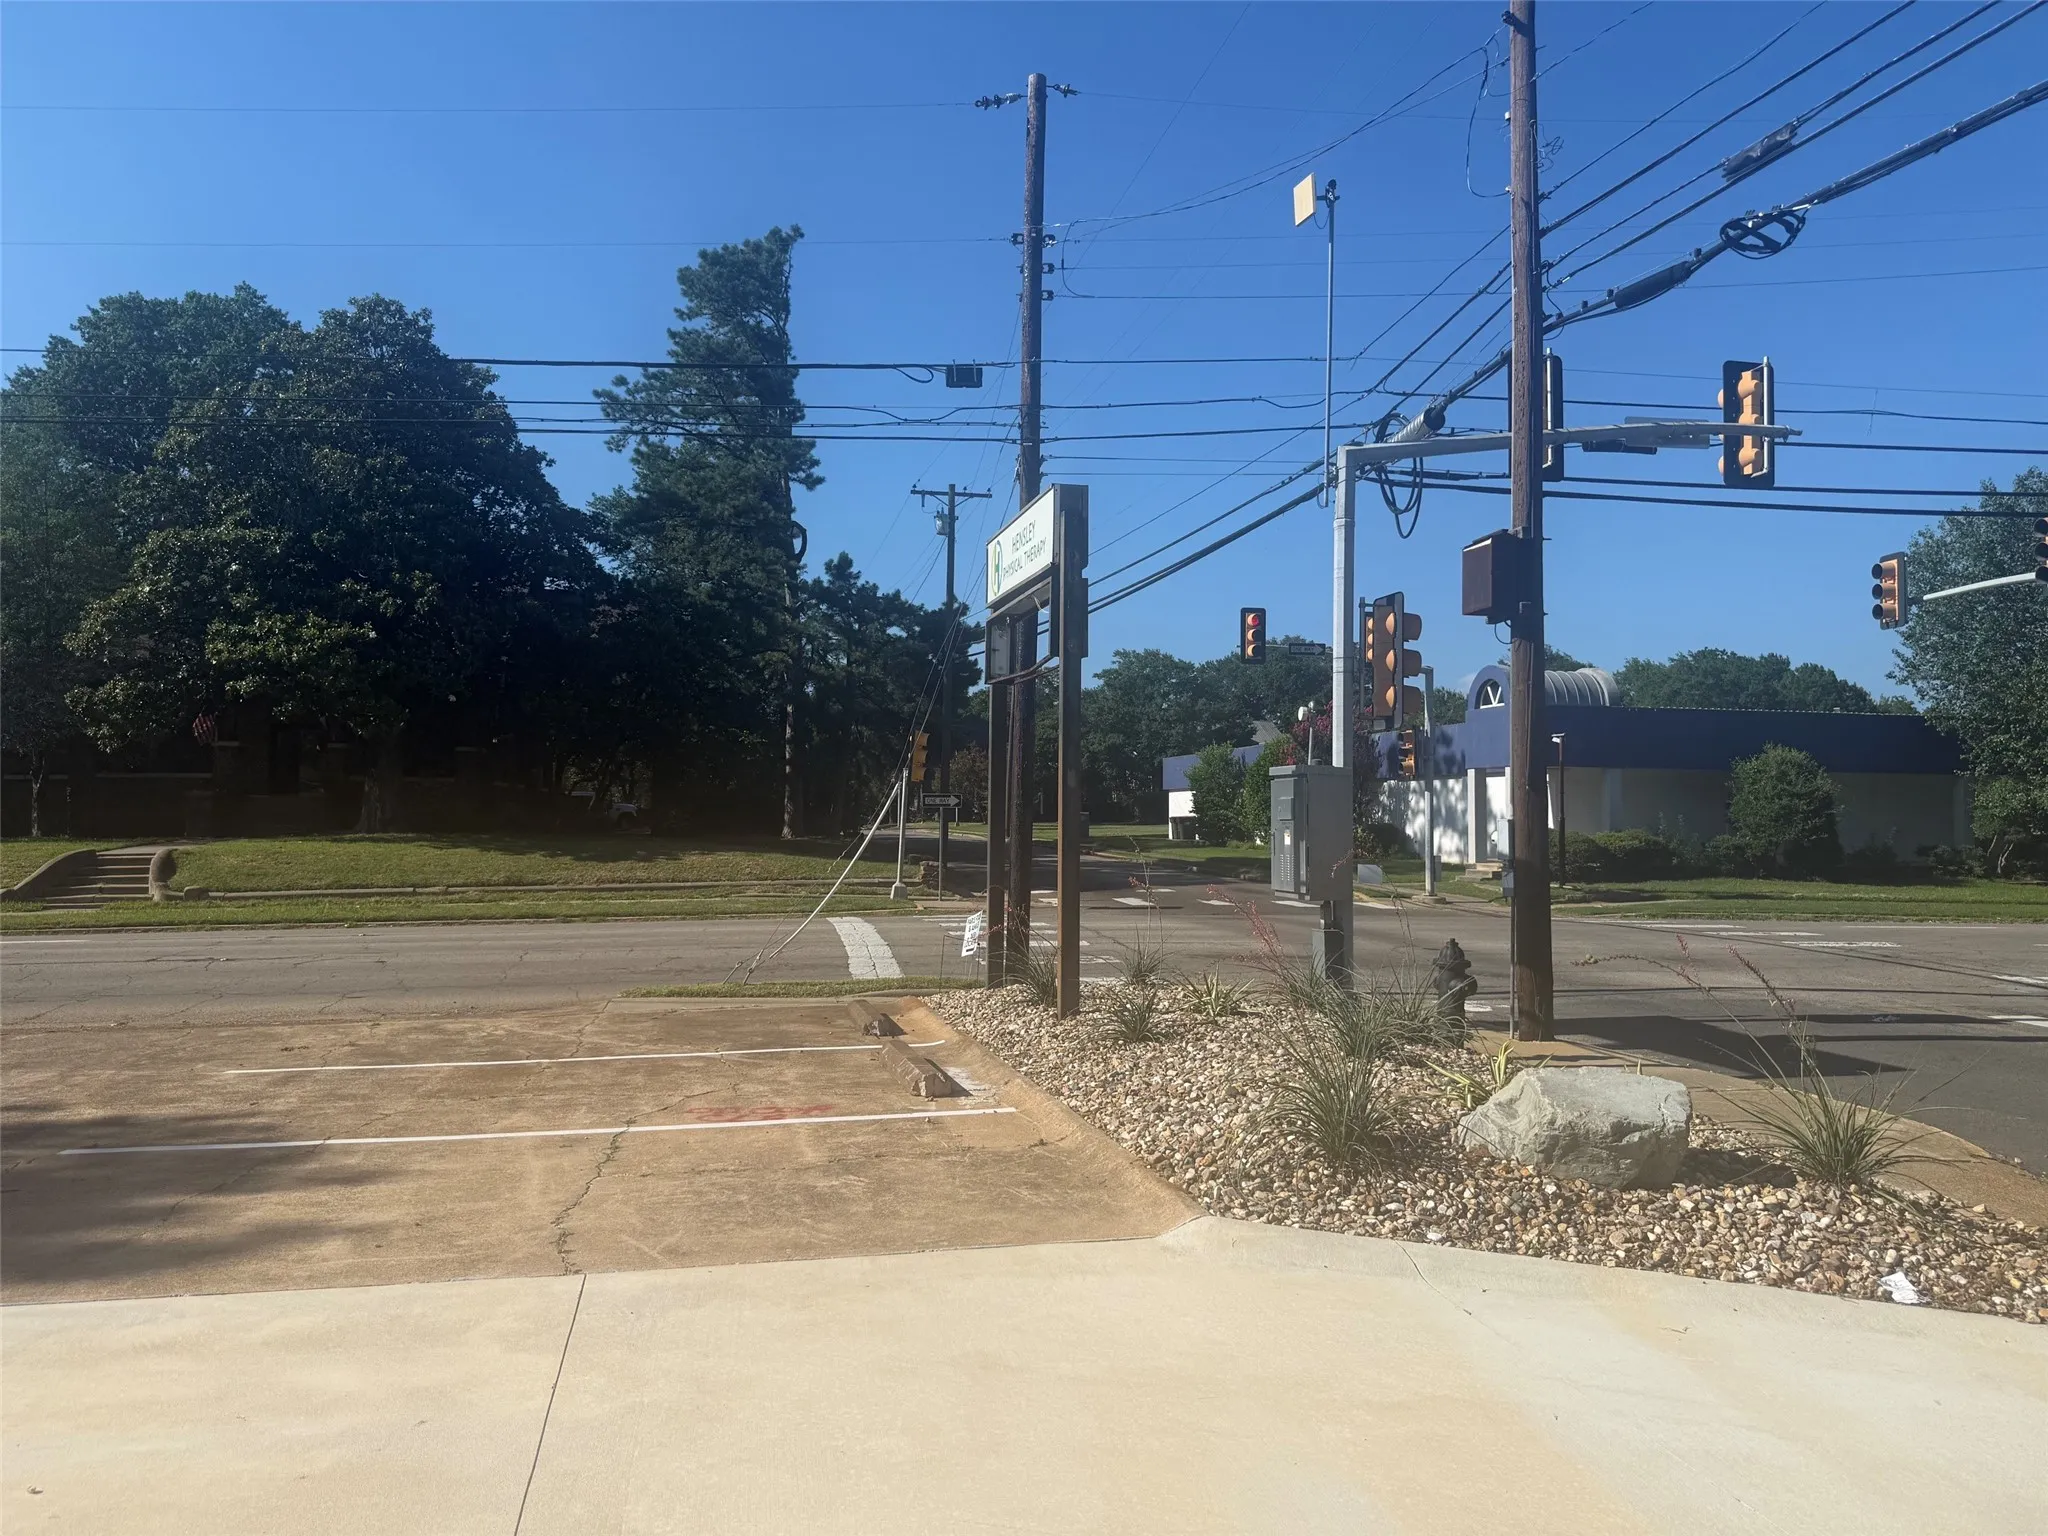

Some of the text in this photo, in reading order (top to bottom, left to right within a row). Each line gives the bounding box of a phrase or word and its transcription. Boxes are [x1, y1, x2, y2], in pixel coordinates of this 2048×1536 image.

[1012, 520, 1036, 554] HENSLEY
[1003, 537, 1047, 580] PHYSICAL THERAPY
